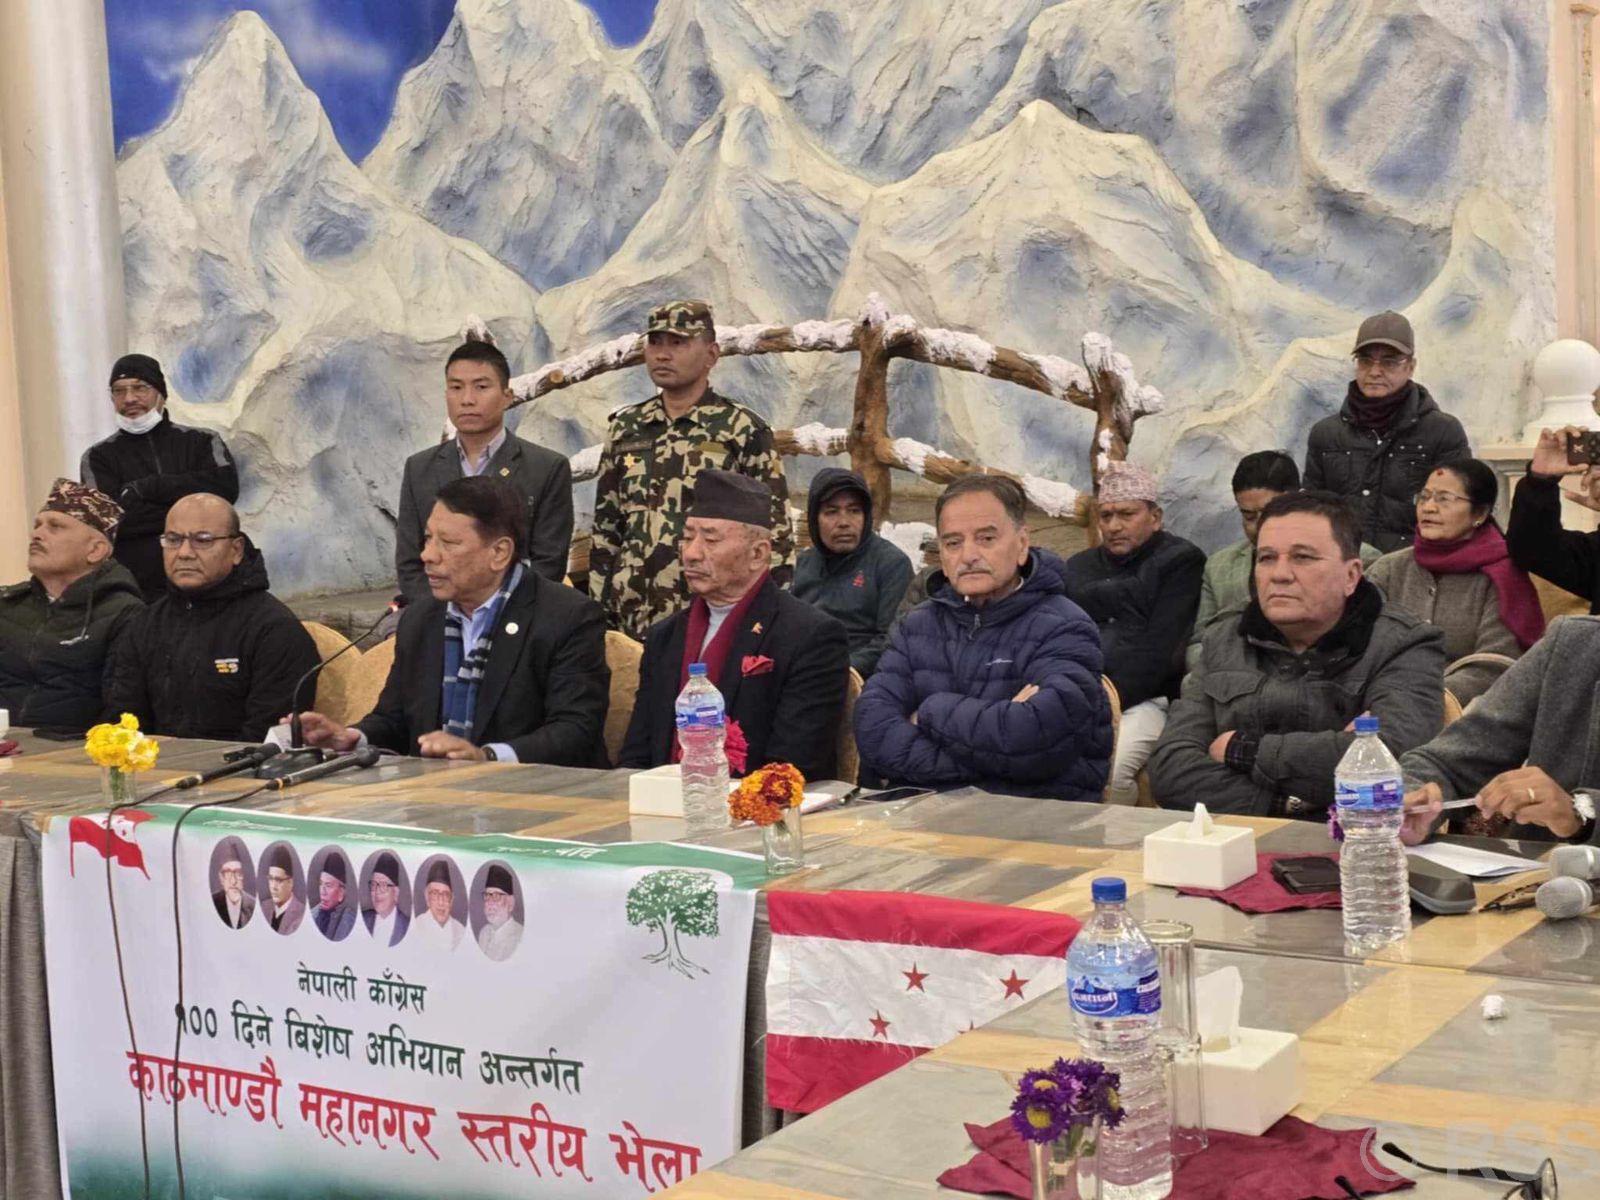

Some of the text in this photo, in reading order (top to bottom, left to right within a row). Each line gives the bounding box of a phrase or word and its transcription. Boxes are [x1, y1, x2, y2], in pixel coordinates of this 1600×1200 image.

[297, 961, 357, 1001] नेपाली
[230, 999, 273, 1049] दिने
[365, 1023, 465, 1079] अभियान
[478, 1048, 584, 1094] अन्तर्गत
[298, 1083, 440, 1161] महानगर
[457, 1102, 593, 1182] स्तरीय
[608, 1120, 703, 1194] भेला
